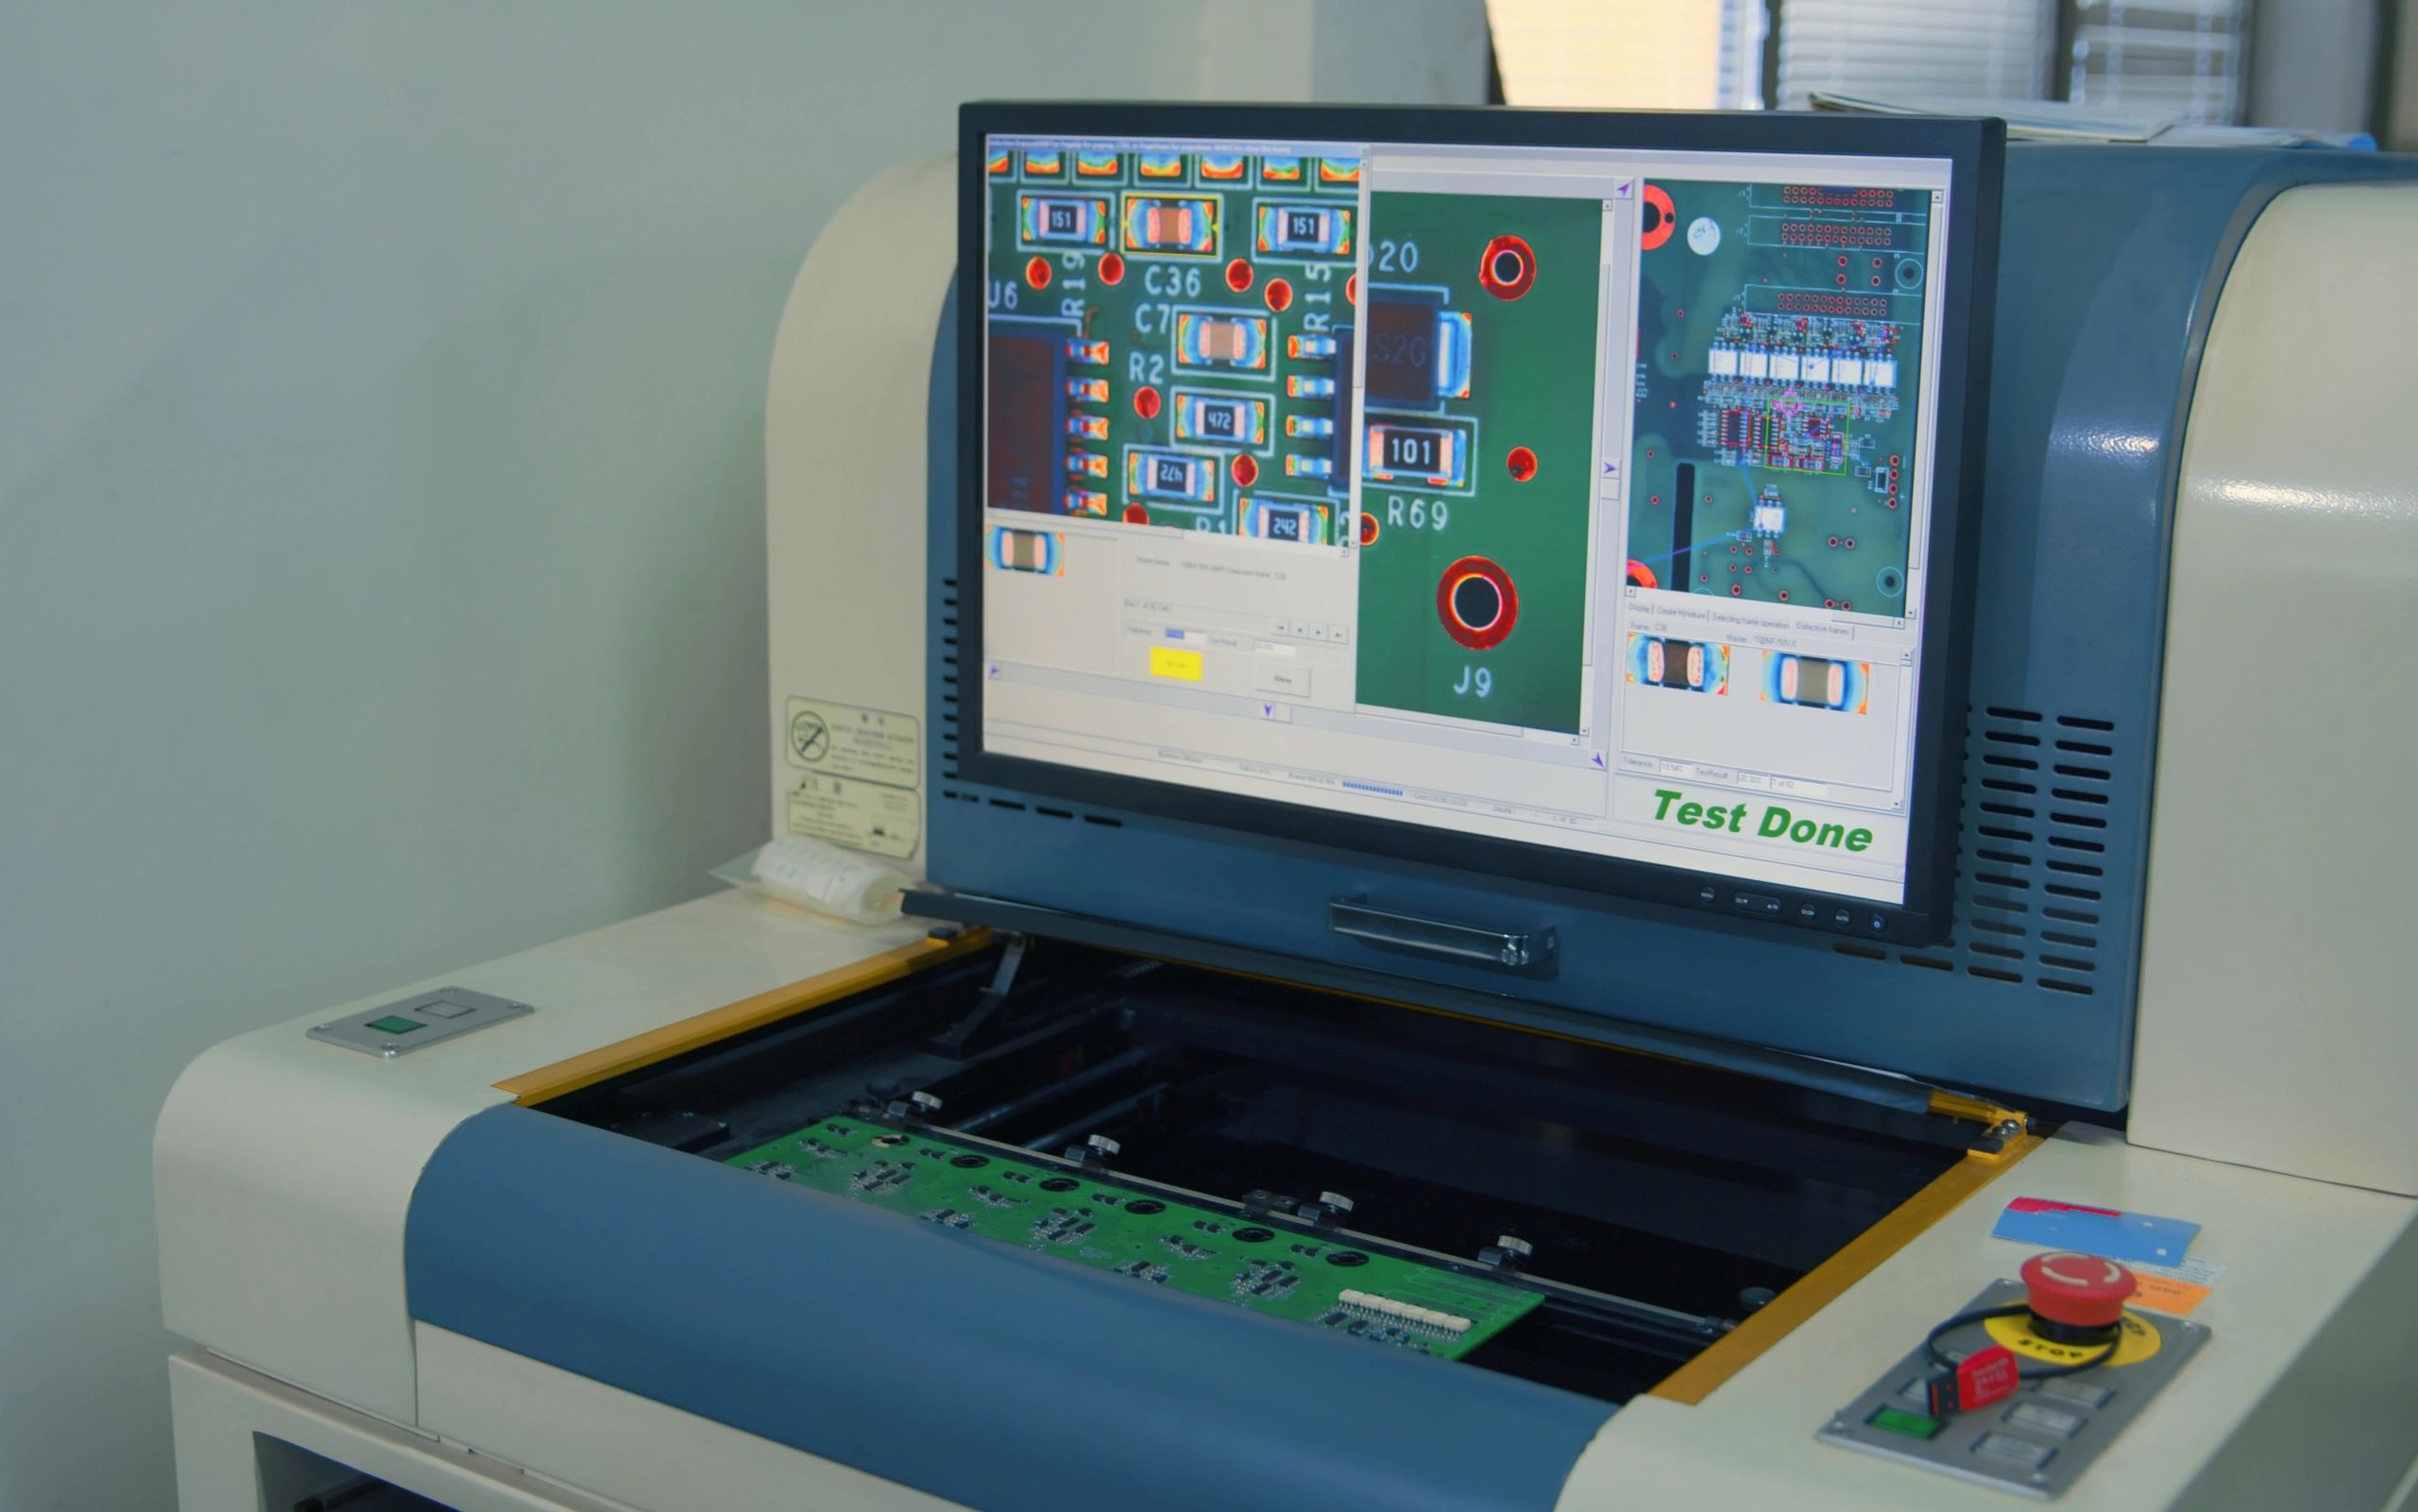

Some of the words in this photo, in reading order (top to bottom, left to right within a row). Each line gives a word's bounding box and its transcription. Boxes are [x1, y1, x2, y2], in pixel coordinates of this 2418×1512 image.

[1051, 210, 1071, 229] 151
[1293, 216, 1315, 234] 151
[1061, 252, 1085, 317] R19
[1145, 265, 1201, 297] C36
[988, 282, 1017, 310] U6
[1303, 265, 1331, 332] R15
[1135, 303, 1171, 333] C7
[1130, 352, 1164, 384] R2
[1208, 412, 1231, 430] 472
[1392, 436, 1431, 465] 101
[1273, 518, 1298, 536] 242
[1388, 496, 1449, 532] R69
[1657, 605, 1677, 615] Create
[1711, 613, 1741, 625] Selecting
[1761, 620, 1790, 631] operation
[1796, 621, 1828, 634] Defective
[1453, 665, 1491, 698] J9
[1653, 789, 1746, 833] Test
[1757, 806, 1873, 852] Done
[2018, 1337, 2083, 1358] STOP
